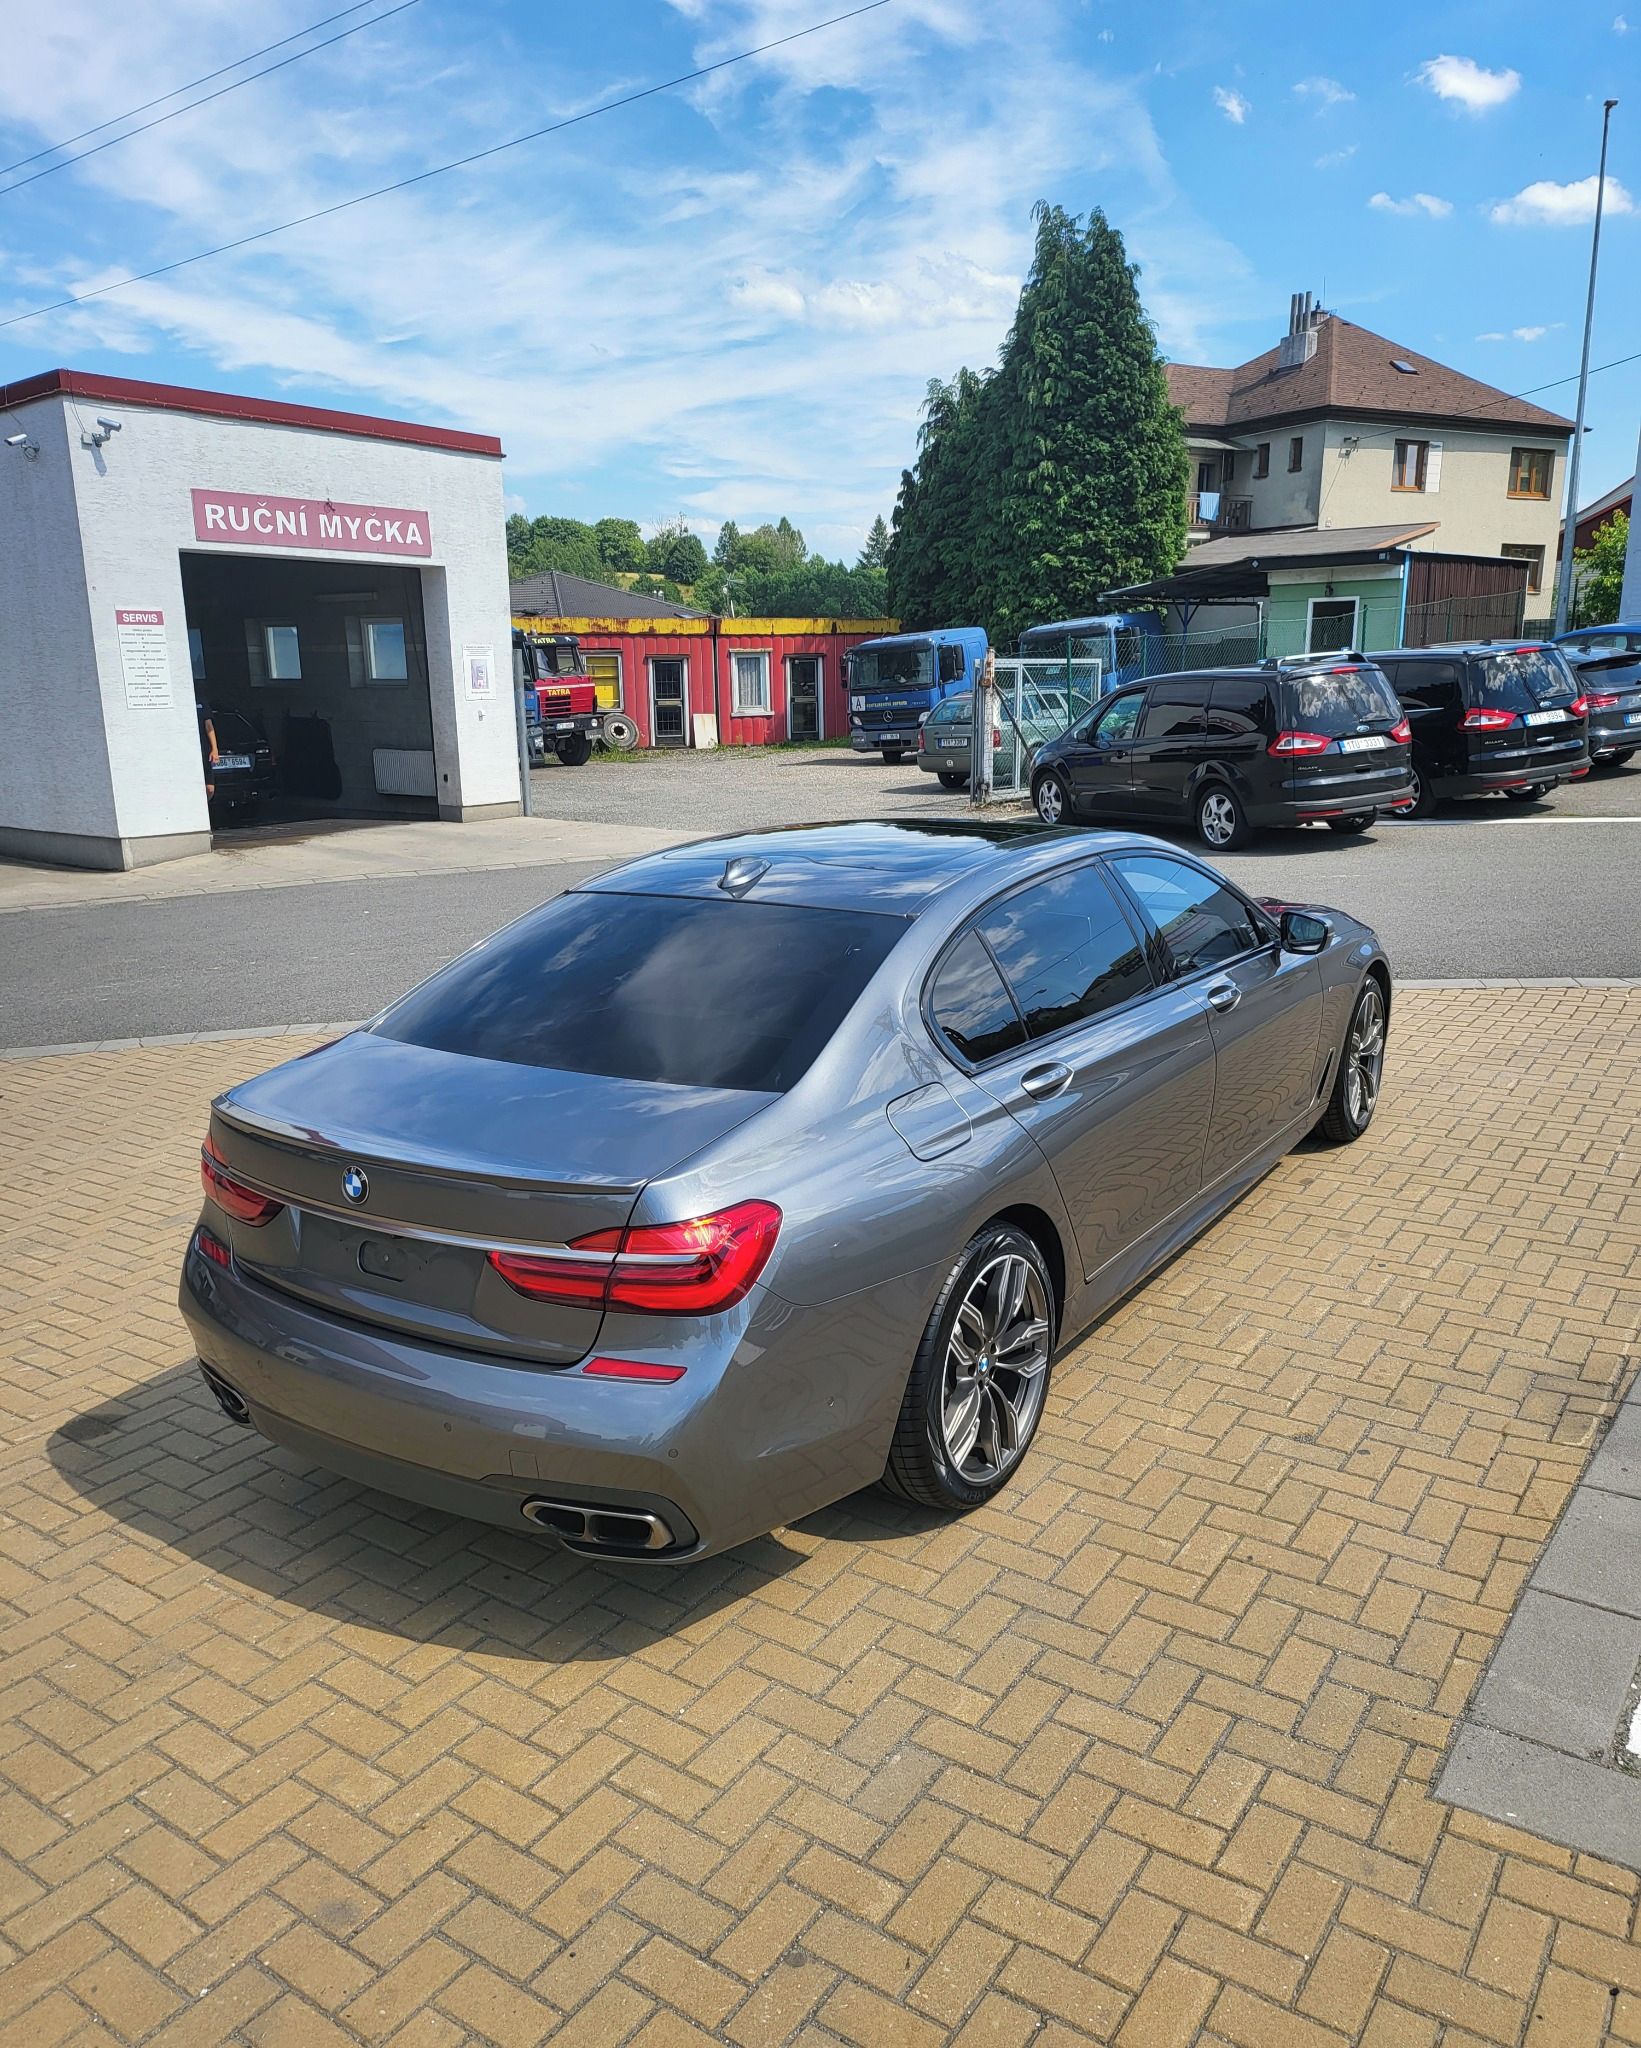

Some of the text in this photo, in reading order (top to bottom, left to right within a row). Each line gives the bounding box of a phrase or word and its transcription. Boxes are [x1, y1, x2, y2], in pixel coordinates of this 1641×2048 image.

[204, 501, 423, 545] RUČNÍ MYČKA
[122, 613, 158, 623] SERVIS
[547, 688, 571, 697] TATRA
[855, 697, 862, 711] A
